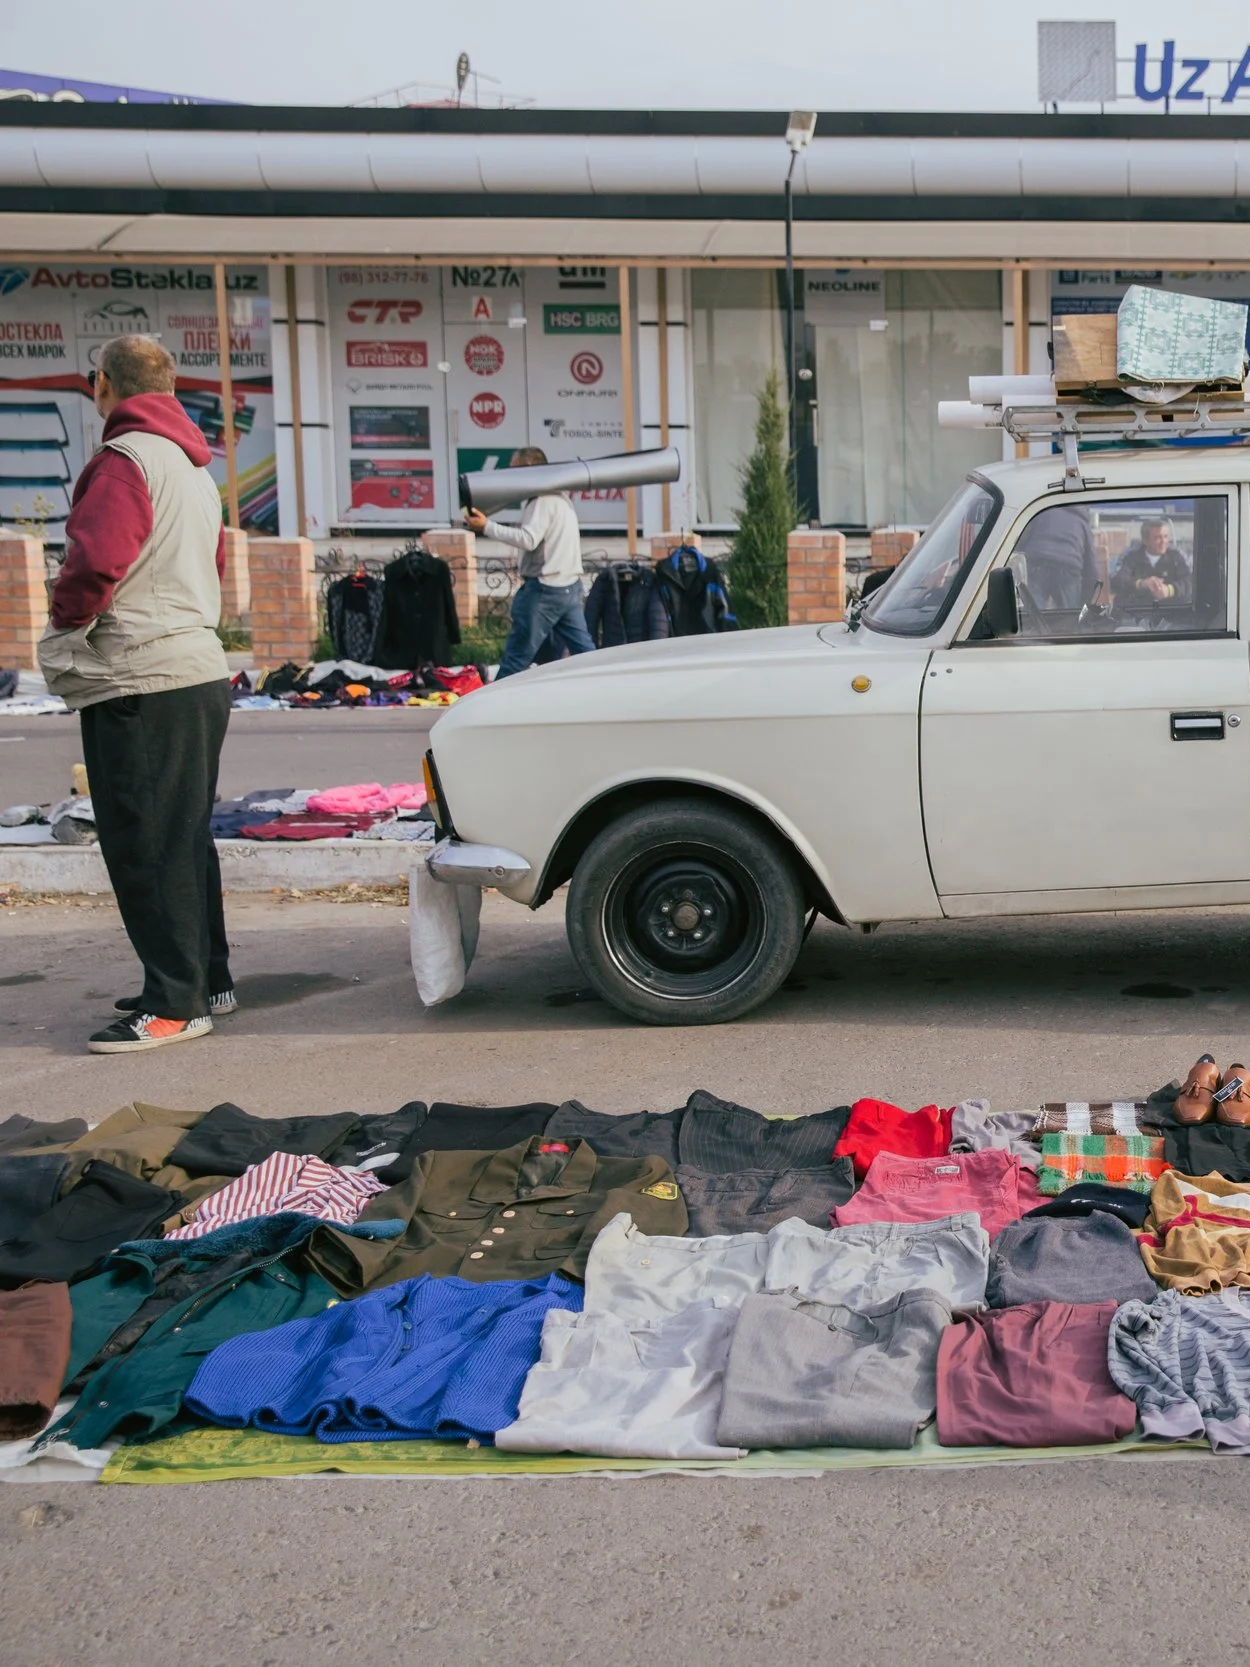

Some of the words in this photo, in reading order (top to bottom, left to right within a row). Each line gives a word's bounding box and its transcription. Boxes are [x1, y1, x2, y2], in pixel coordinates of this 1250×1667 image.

[1133, 40, 1209, 101] Uz
[31, 267, 258, 290] AvtoSteklauz
[807, 281, 880, 292] NEOLINE
[347, 300, 423, 325] CTR
[550, 311, 582, 327] HSC
[585, 311, 619, 328] BRG
[26, 344, 66, 358] МАРОК
[181, 353, 268, 367] АССОРТМЕНТЕ
[351, 352, 407, 365] BRISK
[472, 400, 503, 414] NPR
